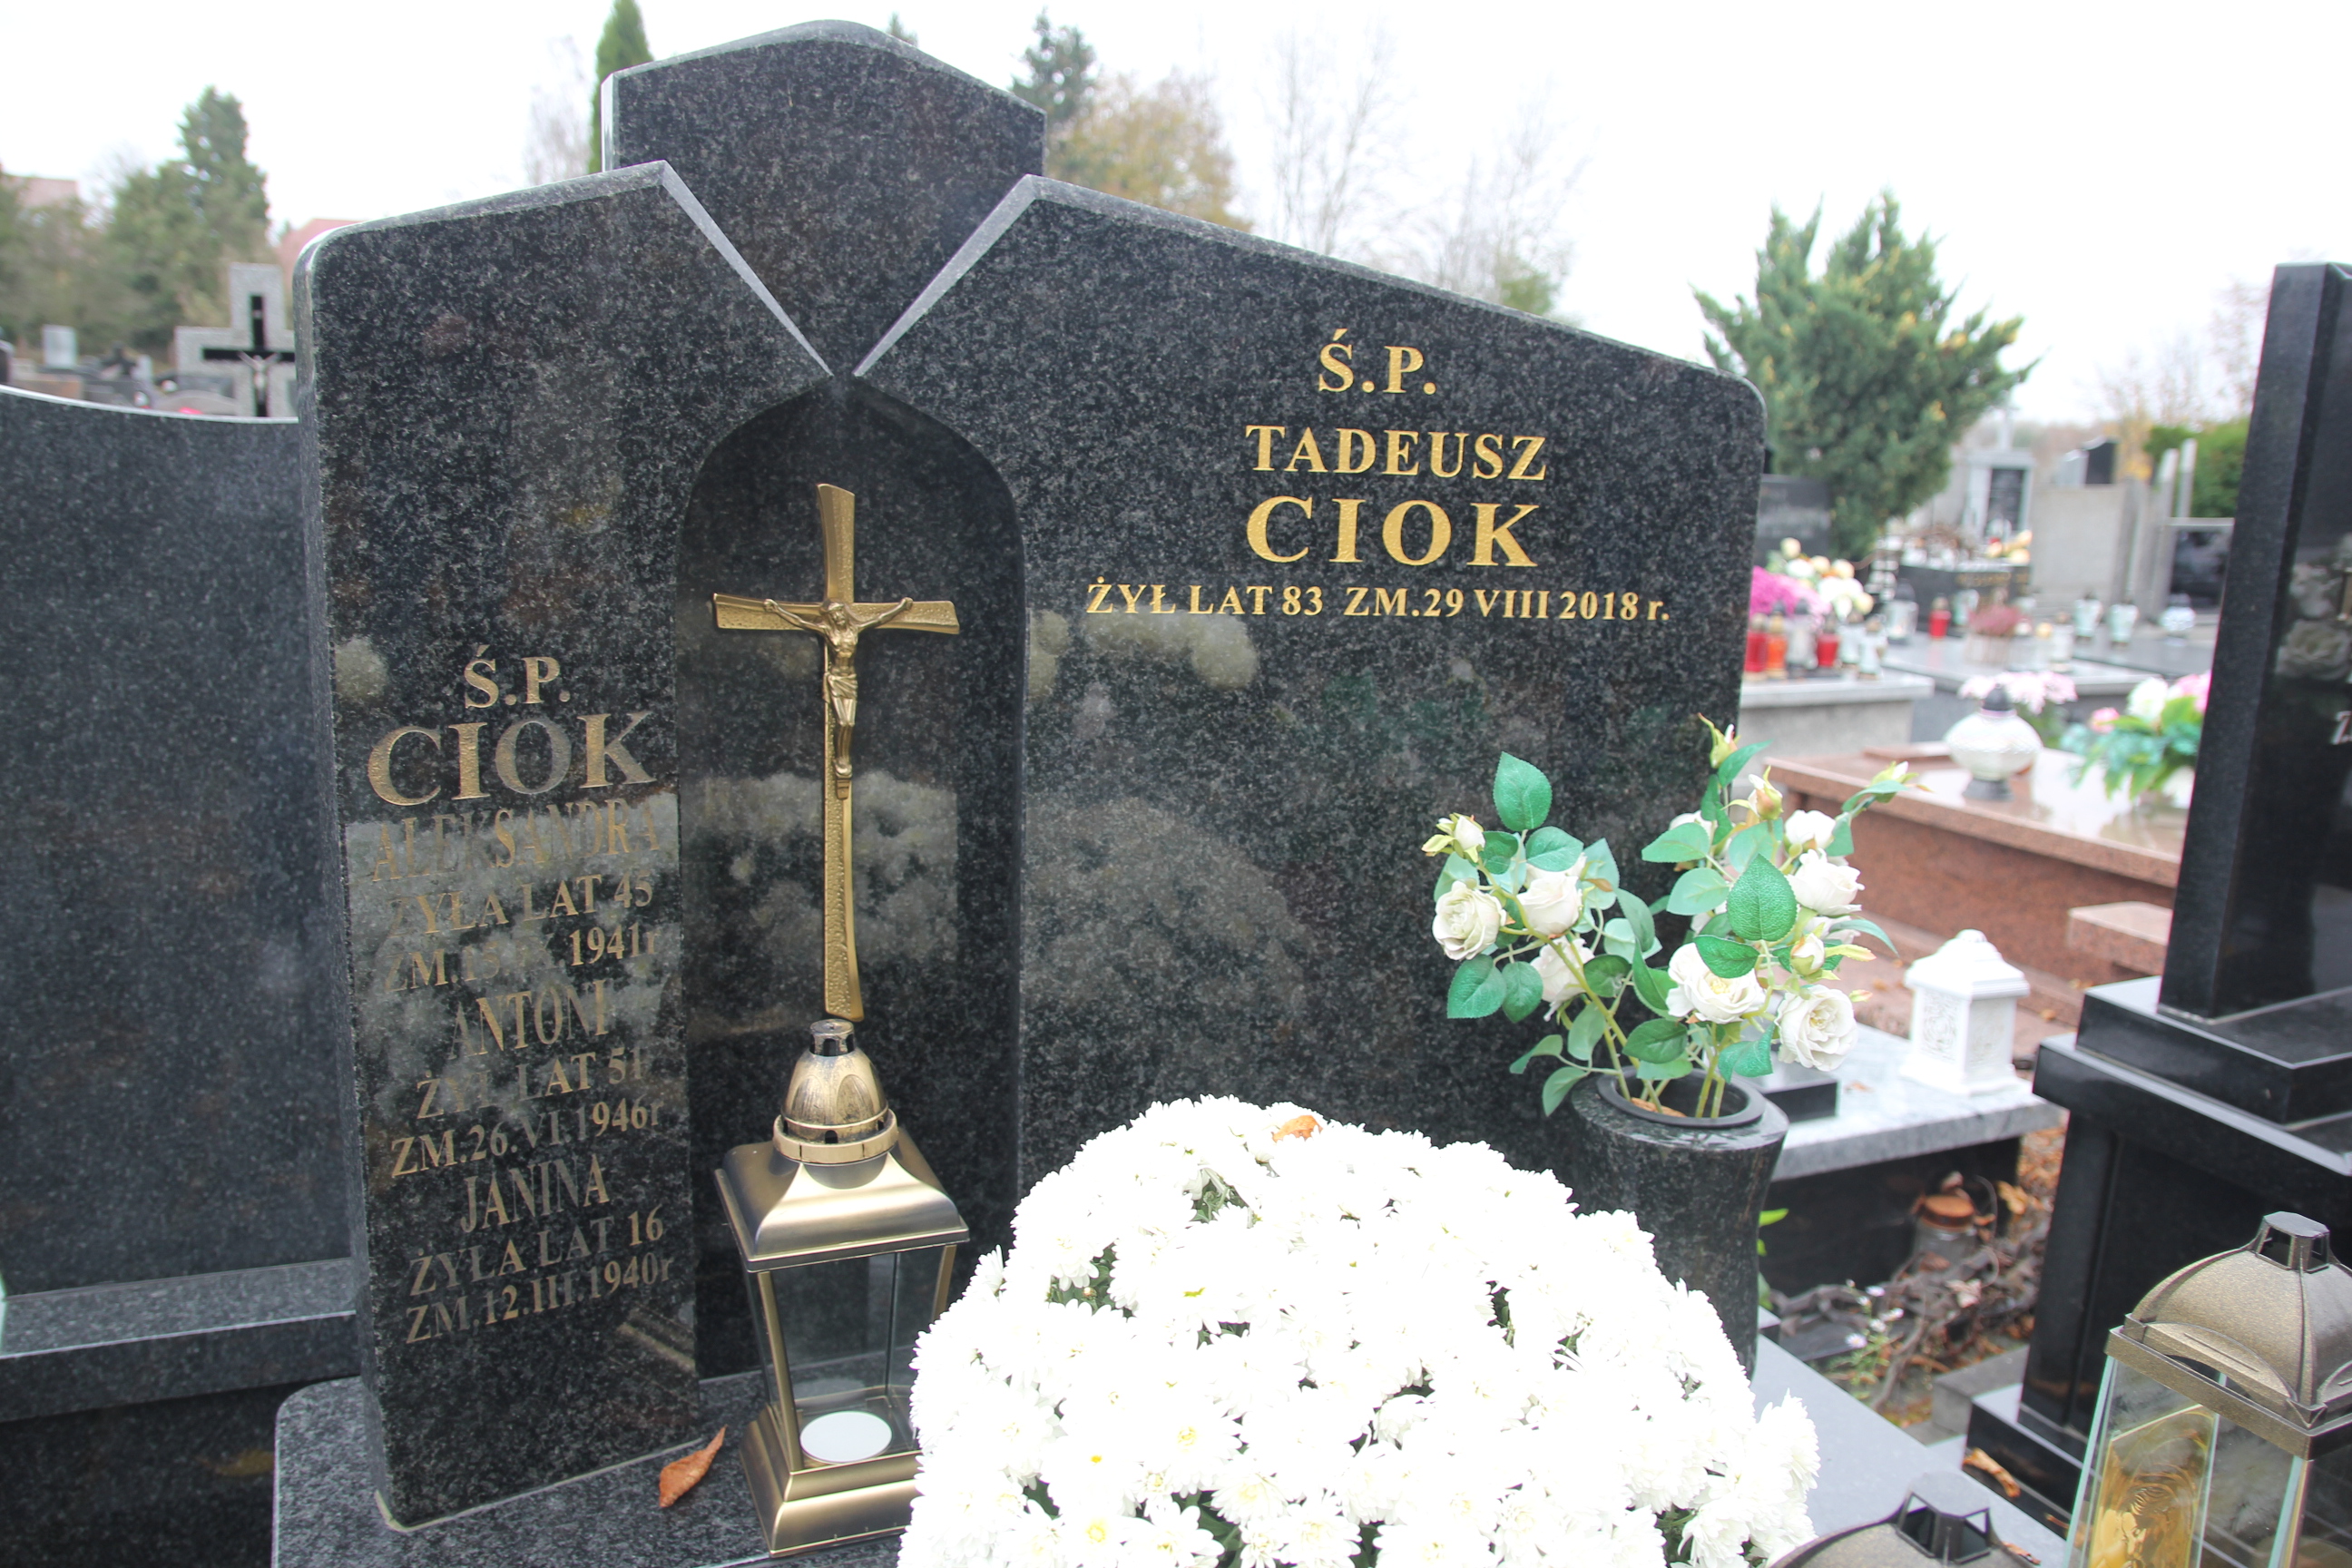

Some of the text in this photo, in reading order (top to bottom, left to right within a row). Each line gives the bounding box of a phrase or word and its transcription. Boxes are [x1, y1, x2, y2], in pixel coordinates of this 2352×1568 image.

[1318, 328, 1437, 396] Ś.P.
[1245, 424, 1547, 482] TADEUSZ
[1246, 495, 1540, 568] CIOK
[1086, 575, 1671, 621] ŻYŁ LAT 83 ZM.29 VIII 2018 r.
[464, 644, 571, 710] Ś.P.
[368, 710, 658, 807] CIOK
[372, 797, 661, 882] ALEKSANDRA
[520, 873, 603, 922] LAT
[614, 868, 654, 908] 45
[448, 978, 610, 1060] ANTONI
[516, 1051, 597, 1102] LAT
[607, 1046, 643, 1085] 51
[459, 1152, 611, 1233] JANINA
[409, 1203, 664, 1297] ŻYŁA LAT 16
